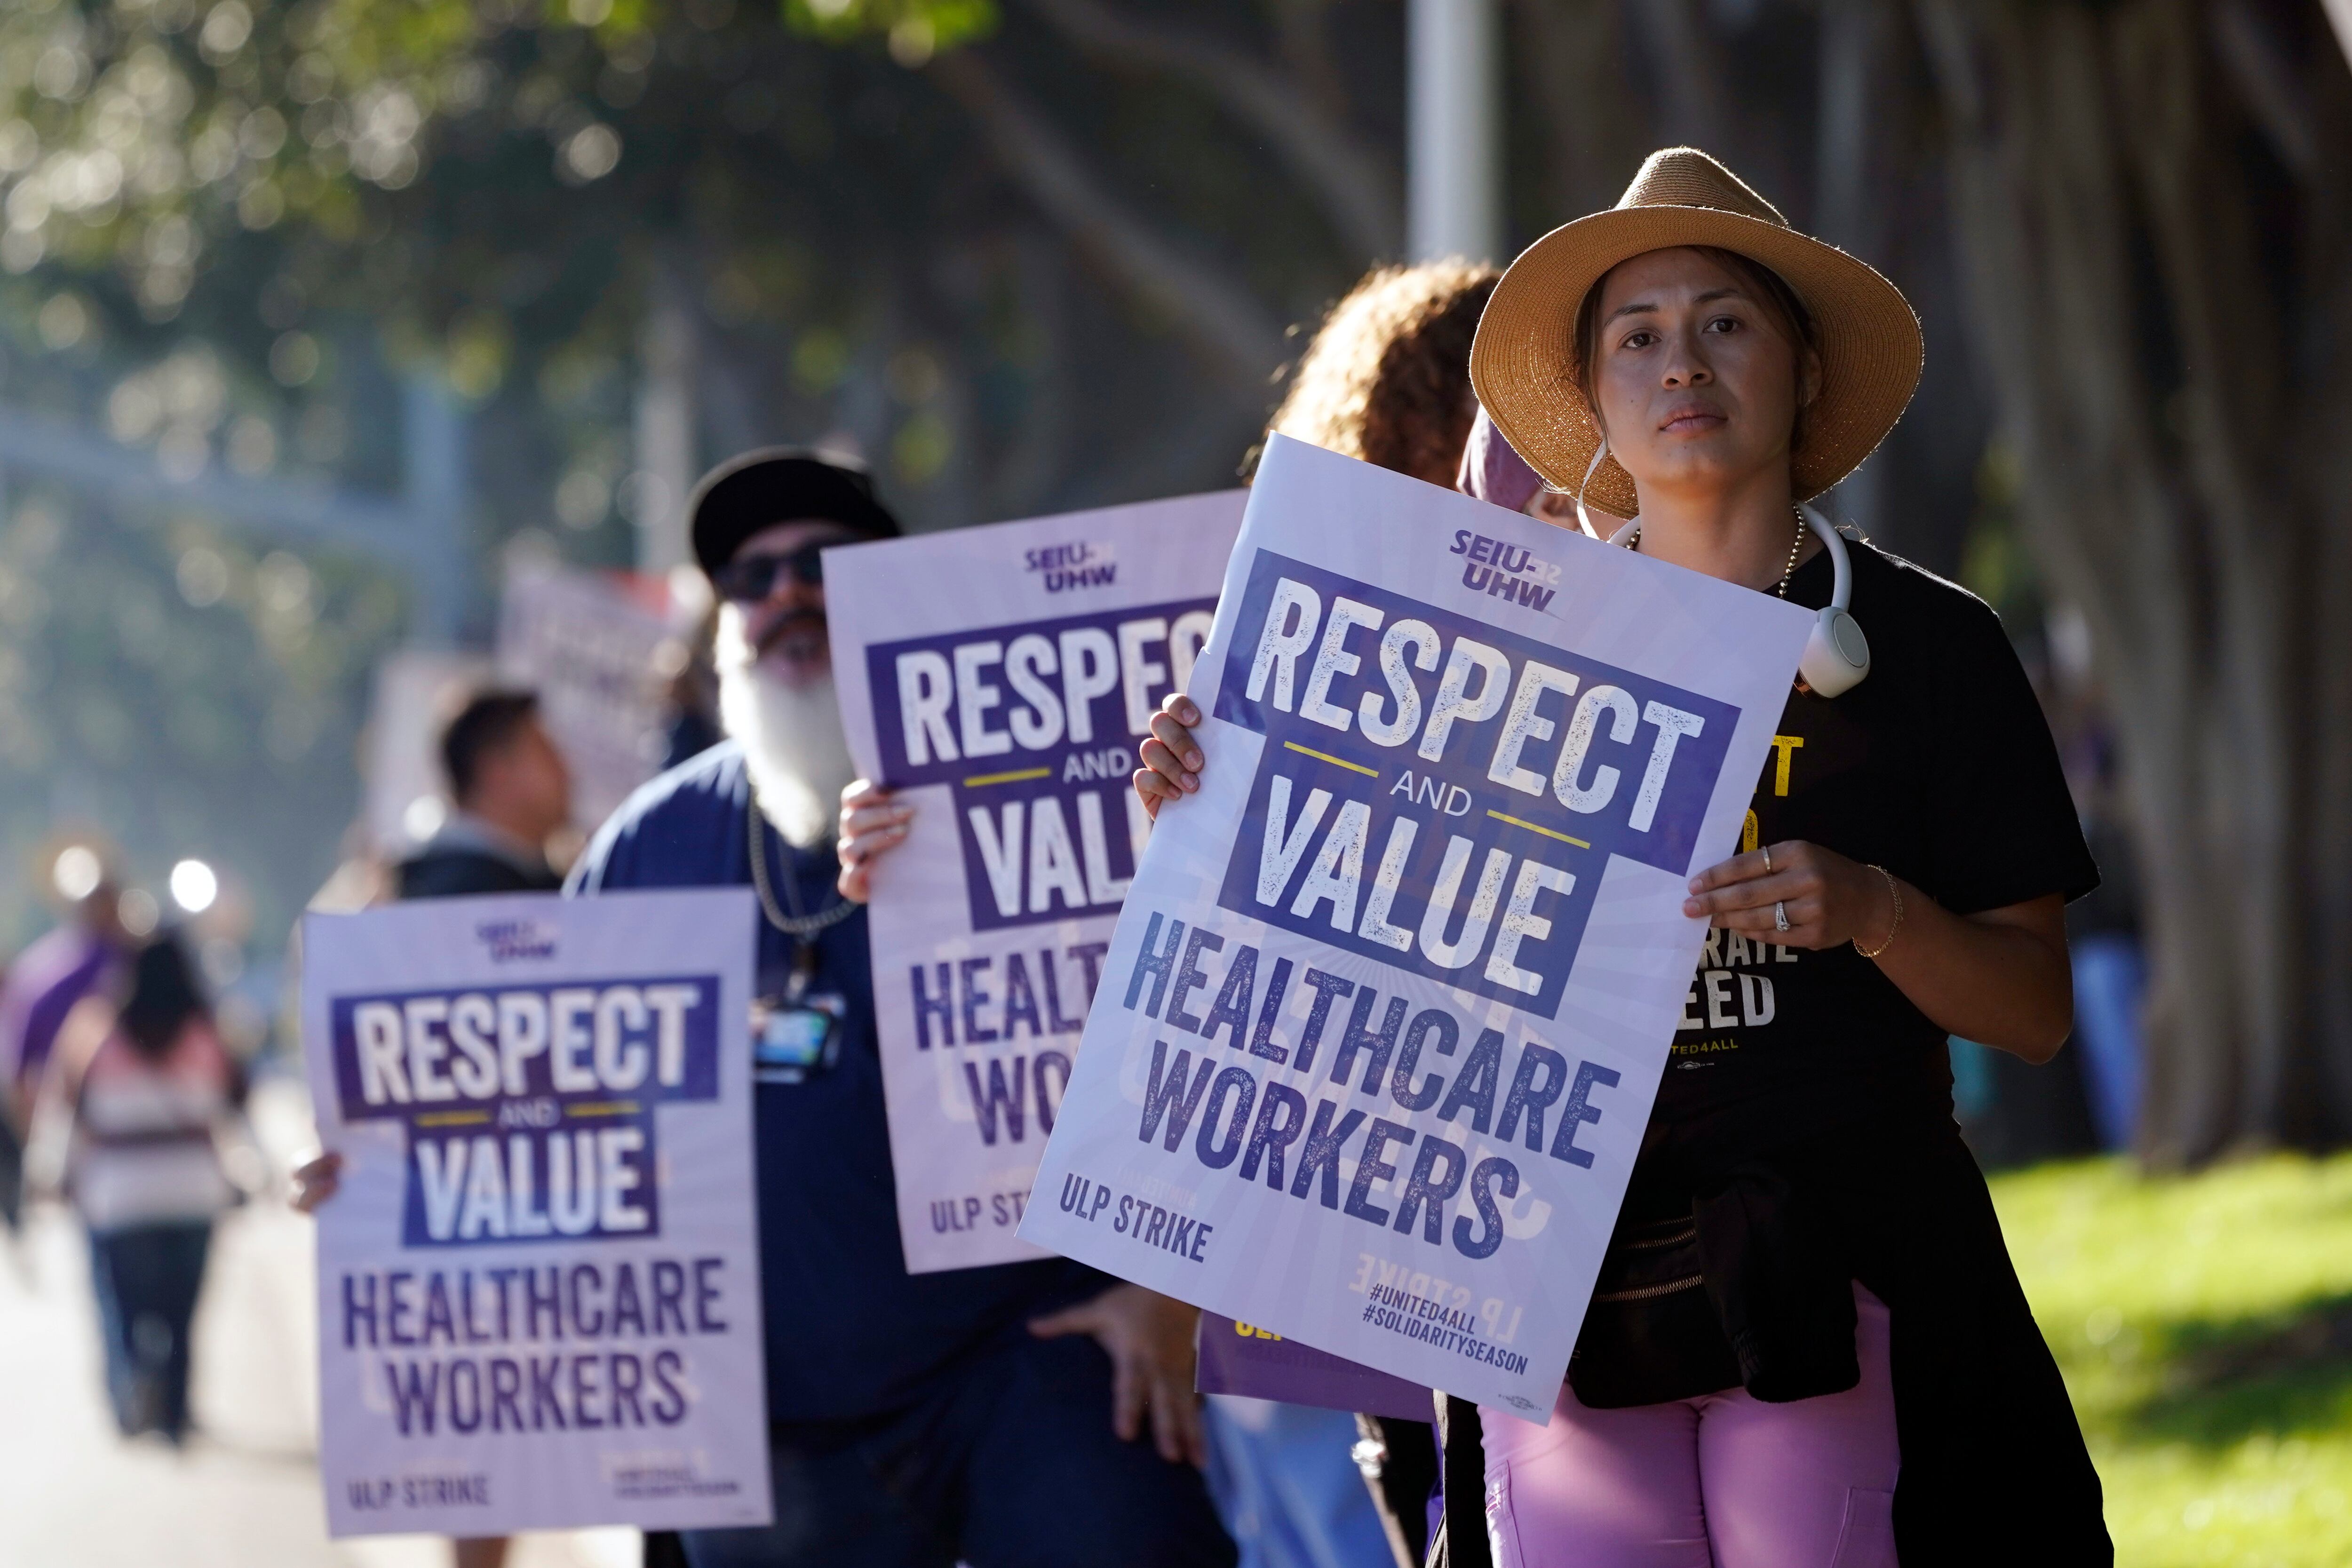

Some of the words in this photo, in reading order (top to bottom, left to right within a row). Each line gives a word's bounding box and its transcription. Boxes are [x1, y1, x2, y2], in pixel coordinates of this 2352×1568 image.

[1045, 563, 1117, 593] UHW
[1449, 530, 1536, 573] SEIU-
[1462, 563, 1556, 612] UHW
[1245, 577, 1705, 833] RESPECT
[1063, 747, 1133, 784] AND
[1390, 770, 1472, 817] AND
[1255, 775, 1576, 996] VALUE
[352, 983, 701, 1106] RESPECT
[1123, 911, 1621, 1170] HEALTHCARE
[498, 1096, 560, 1129] AND
[1138, 1040, 1520, 1259] WORKERS
[415, 1127, 650, 1241] VALUE
[930, 1197, 982, 1234] ULP
[991, 1190, 1032, 1227] ST
[1060, 1173, 1111, 1223] ULP
[1113, 1194, 1214, 1263] STRIKE
[341, 1257, 729, 1350] HEALTHCARE
[1363, 1305, 1528, 1375] #SOLIDARITYSEASON
[1369, 1283, 1475, 1335] #UNITED4ALL
[384, 1348, 688, 1438] WORKERS
